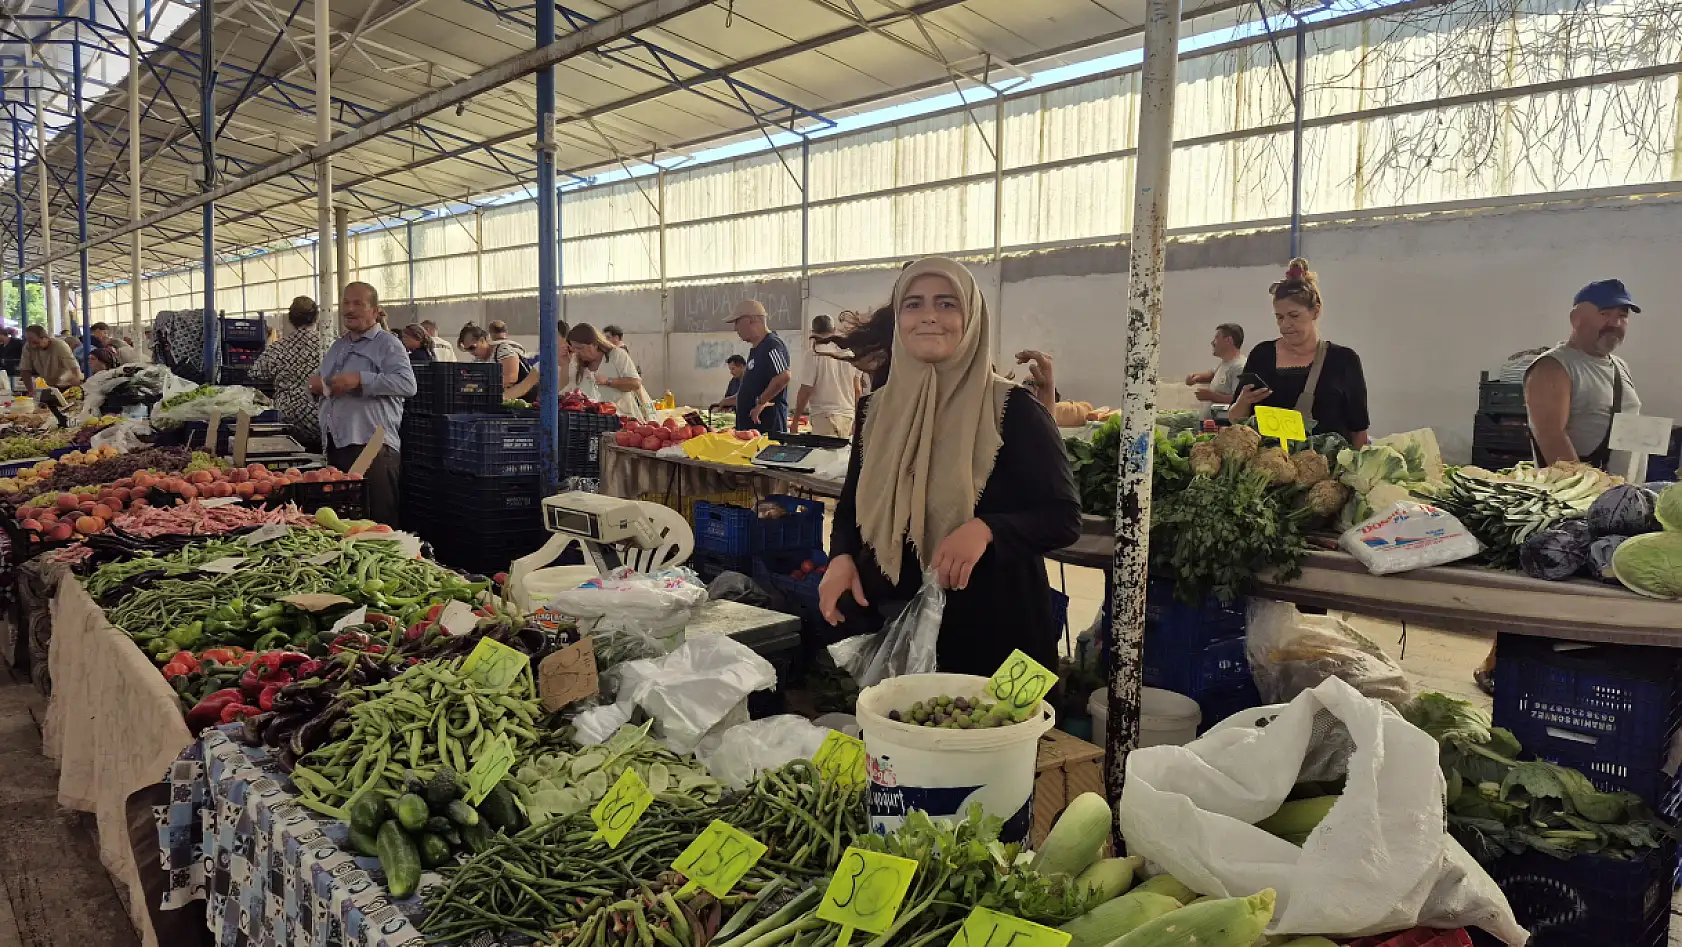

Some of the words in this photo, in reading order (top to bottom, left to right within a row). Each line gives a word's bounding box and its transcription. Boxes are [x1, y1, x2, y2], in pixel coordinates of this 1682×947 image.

[994, 659, 1047, 709] 80
[686, 829, 752, 885] 150
[832, 852, 901, 917] 30
